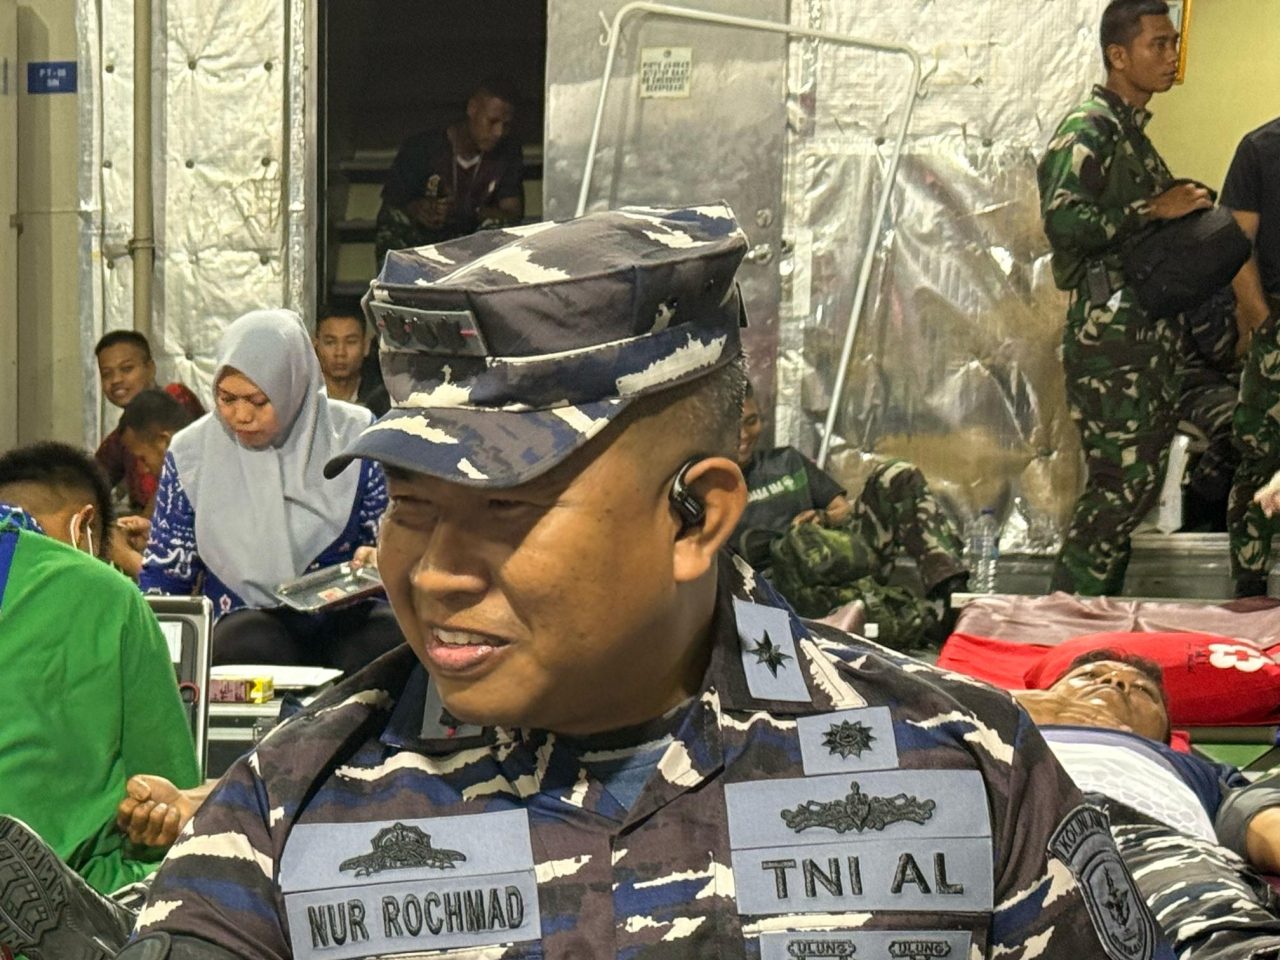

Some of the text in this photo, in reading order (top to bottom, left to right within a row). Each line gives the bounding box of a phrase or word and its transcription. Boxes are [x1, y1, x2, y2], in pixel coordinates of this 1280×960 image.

[761, 852, 964, 899] TNI AL
[307, 885, 525, 949] NUR ROCHMAD
[796, 943, 848, 955] ULUNG
[898, 943, 944, 955] ULUNG
